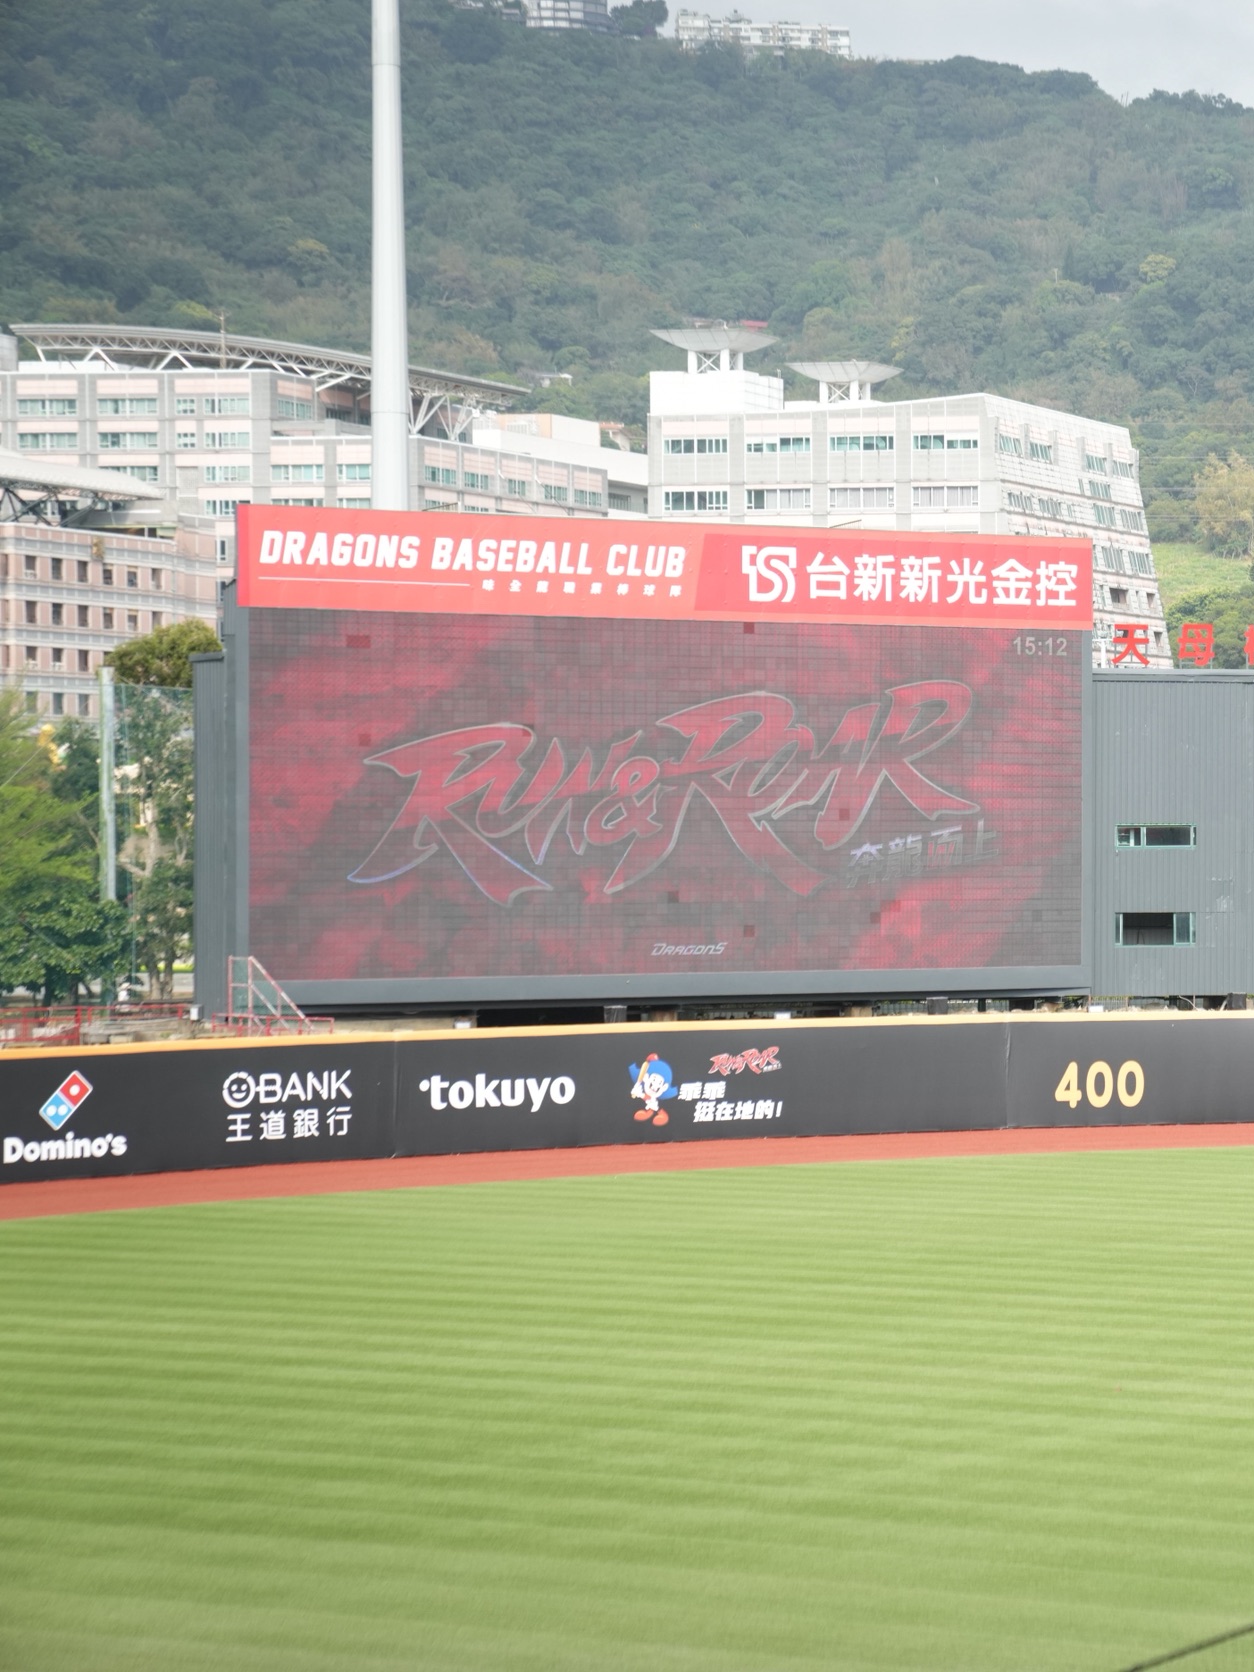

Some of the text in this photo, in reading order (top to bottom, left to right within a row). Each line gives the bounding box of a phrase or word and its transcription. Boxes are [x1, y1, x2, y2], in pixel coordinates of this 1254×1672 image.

[258, 530, 686, 578] DRAGONS BASEBALL CLUB
[806, 551, 1079, 607] 台新新光金控
[1012, 637, 1068, 656] 15:12
[428, 1073, 576, 1112] tokuyo
[1054, 1059, 1145, 1109] 400
[225, 1106, 353, 1143] 王道銀行
[2, 1130, 128, 1164] Domino's
